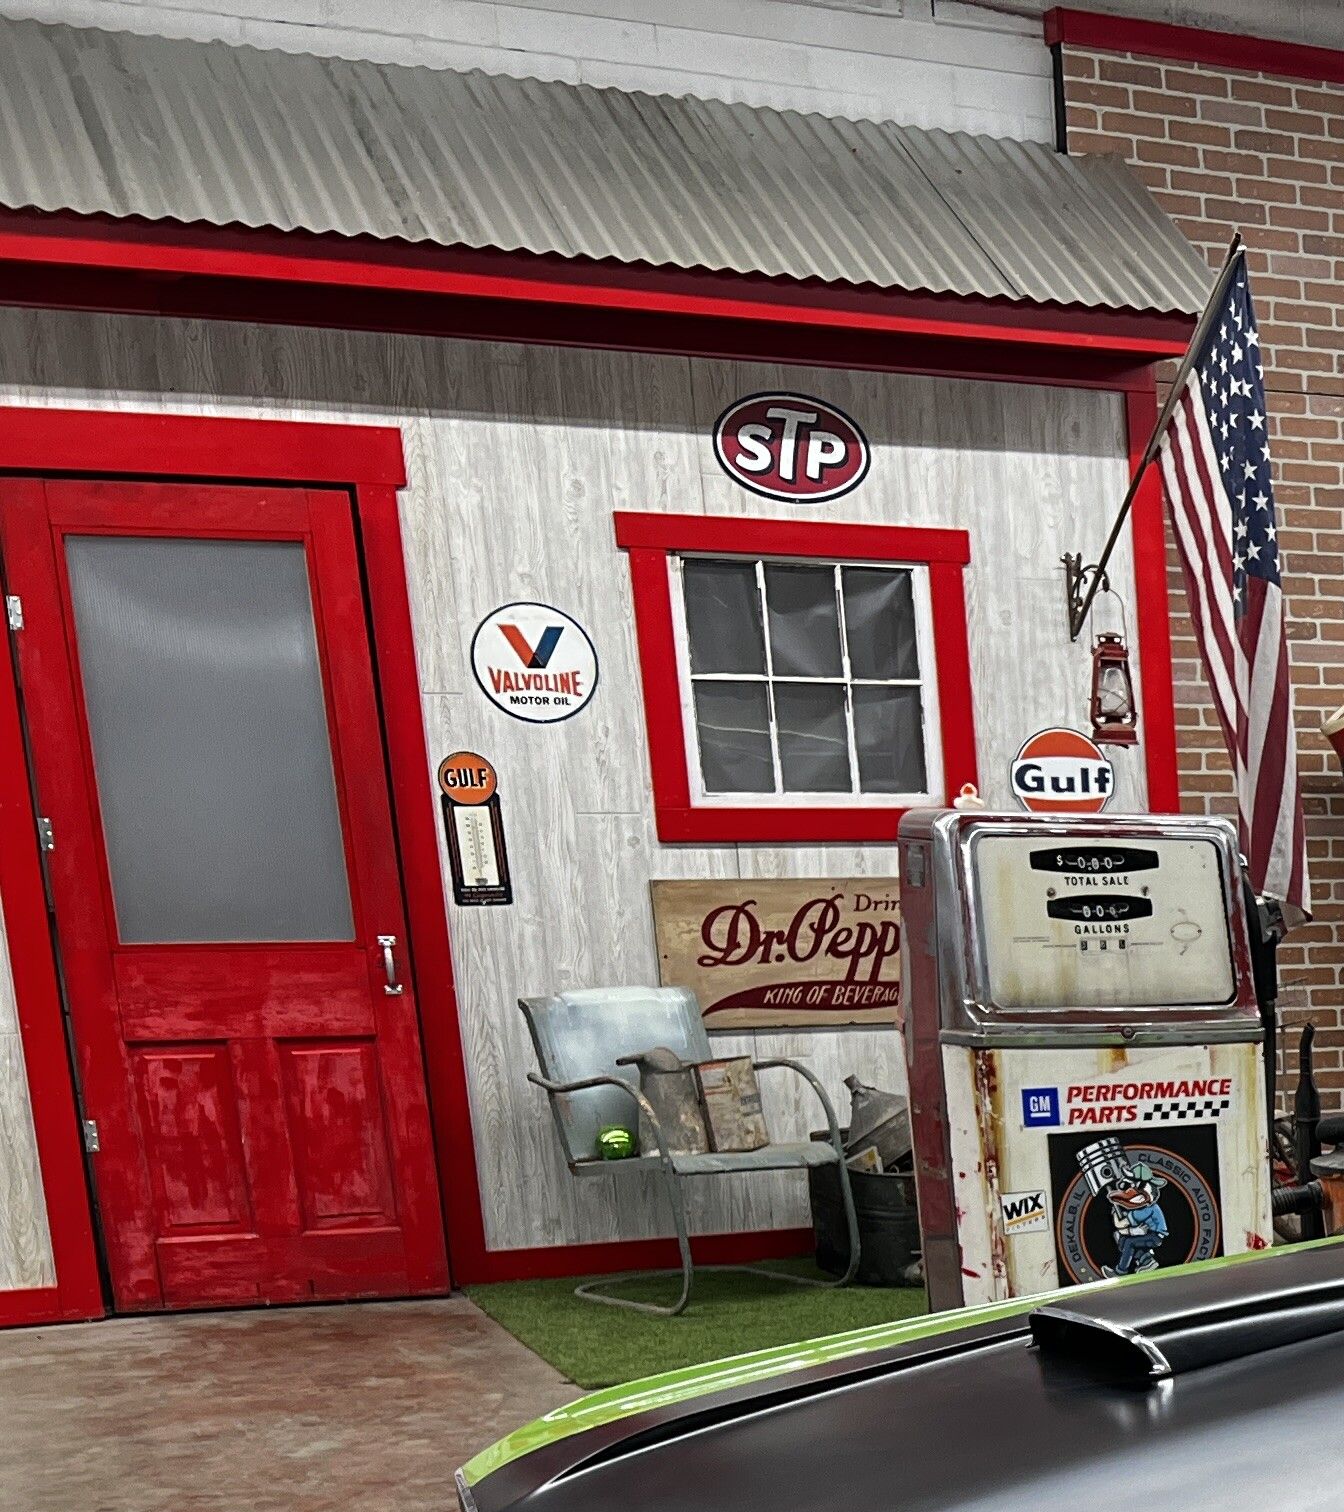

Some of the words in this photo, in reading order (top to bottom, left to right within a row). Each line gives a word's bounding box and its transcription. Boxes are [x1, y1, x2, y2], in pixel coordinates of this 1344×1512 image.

[735, 407, 847, 480] STP
[487, 665, 584, 698] VALVOLINE
[509, 695, 550, 706] MOTOR
[553, 696, 572, 707] OIL
[443, 767, 487, 788] GULF
[1014, 763, 1111, 794] Gulf
[1064, 875, 1098, 887] TOTAL
[1101, 875, 1129, 887] SALE
[1074, 924, 1130, 935] GALLONS
[763, 989, 803, 1004] KING
[806, 985, 829, 1004] OF
[1066, 1078, 1232, 1104] PERFORMANCE
[1029, 1095, 1051, 1112] GM
[1067, 1105, 1138, 1126] PARTS
[1137, 1152, 1192, 1184] CLASSIC
[1191, 1186, 1212, 1222] AUTO
[1003, 1193, 1044, 1220] WIX
